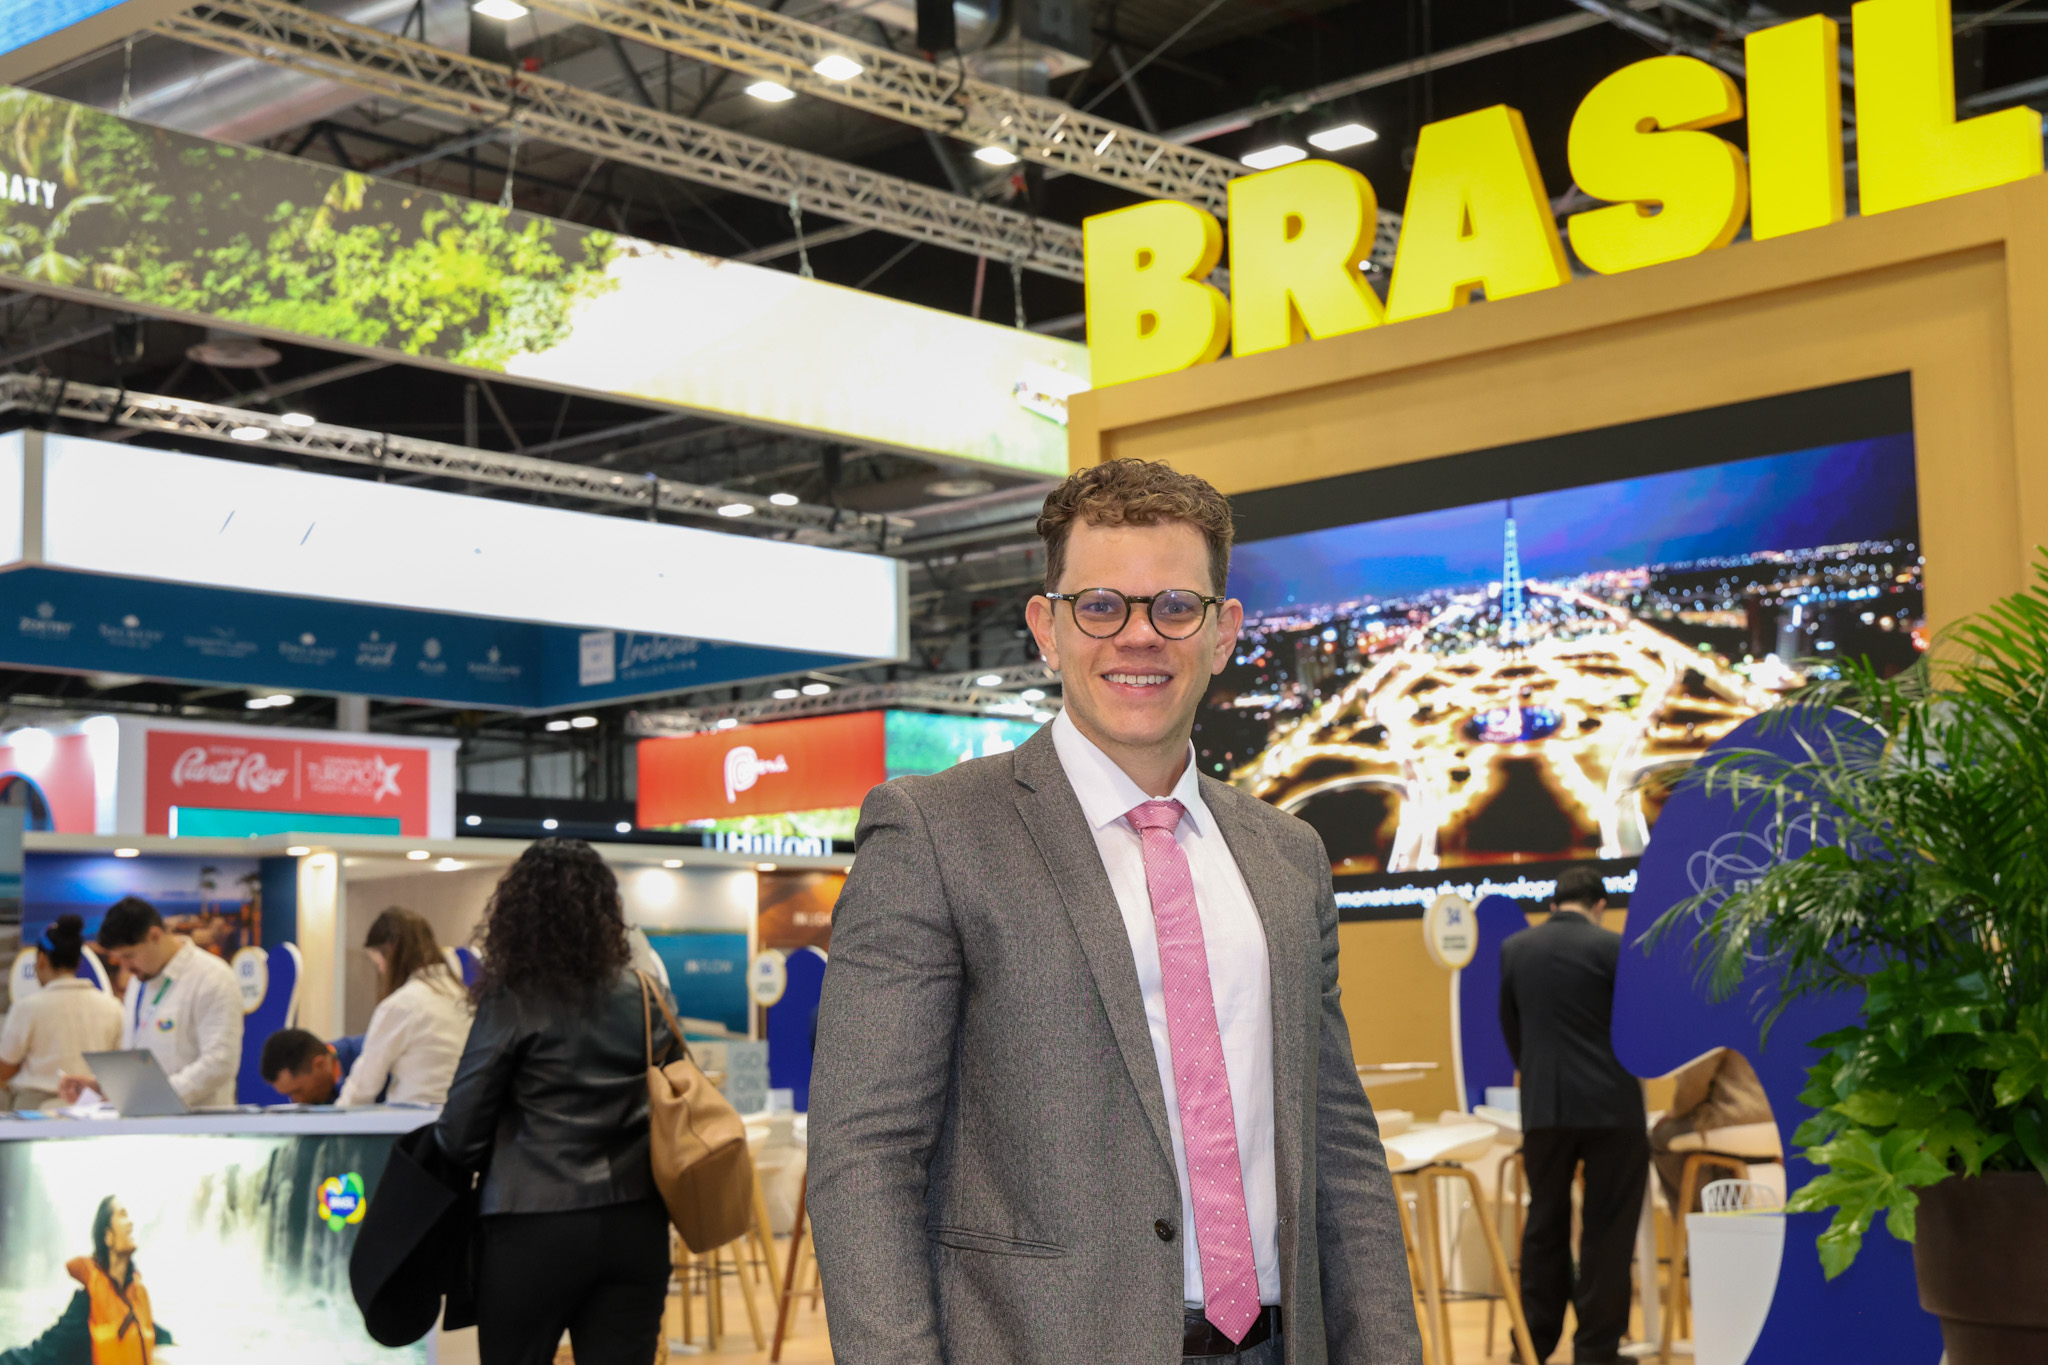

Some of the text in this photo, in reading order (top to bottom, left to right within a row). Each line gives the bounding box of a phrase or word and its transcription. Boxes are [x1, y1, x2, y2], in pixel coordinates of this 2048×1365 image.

[1083, 0, 2043, 388] BRASIL
[727, 831, 823, 857] Hilton
[1333, 884, 1437, 910] monstrating
[1474, 875, 1558, 903] develop
